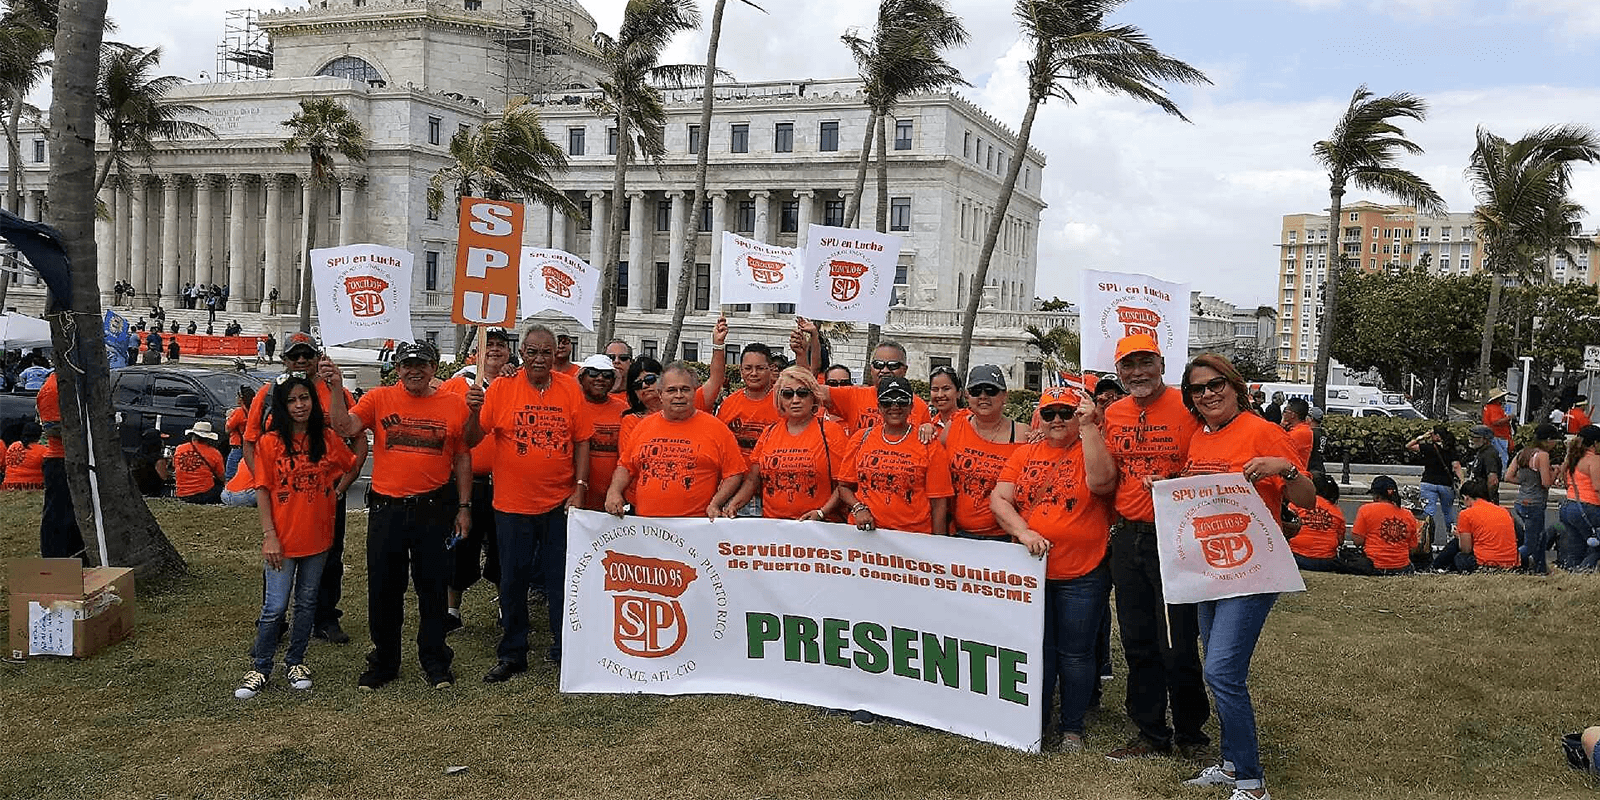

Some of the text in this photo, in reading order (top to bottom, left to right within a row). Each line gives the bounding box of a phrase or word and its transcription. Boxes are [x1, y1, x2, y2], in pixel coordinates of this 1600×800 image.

[820, 237, 884, 252] SPU en Lucha
[327, 254, 402, 267] SPU en Lucha
[461, 202, 513, 323] SPU
[1098, 282, 1171, 302] SPU en Lucha
[514, 411, 538, 426] NO
[640, 444, 662, 458] NO
[1172, 488, 1195, 502] SPU
[1199, 487, 1213, 498] en
[642, 525, 686, 548] UNIDOS
[688, 546, 699, 558] de
[718, 542, 842, 561] Servidores
[950, 563, 1038, 589] Unidos
[609, 561, 683, 588] CONCILIO 95
[700, 558, 727, 608] PUERTO
[728, 558, 748, 569] de
[752, 560, 811, 573] Puerto
[859, 566, 931, 587] Concilio
[934, 577, 957, 591] 95
[961, 582, 1032, 604] AFSCME
[569, 552, 593, 632] SERVIDORES
[618, 599, 676, 651] SP
[713, 610, 728, 640] RICO
[598, 657, 648, 684] AFSCME,
[745, 611, 1028, 706] PRESENTE
